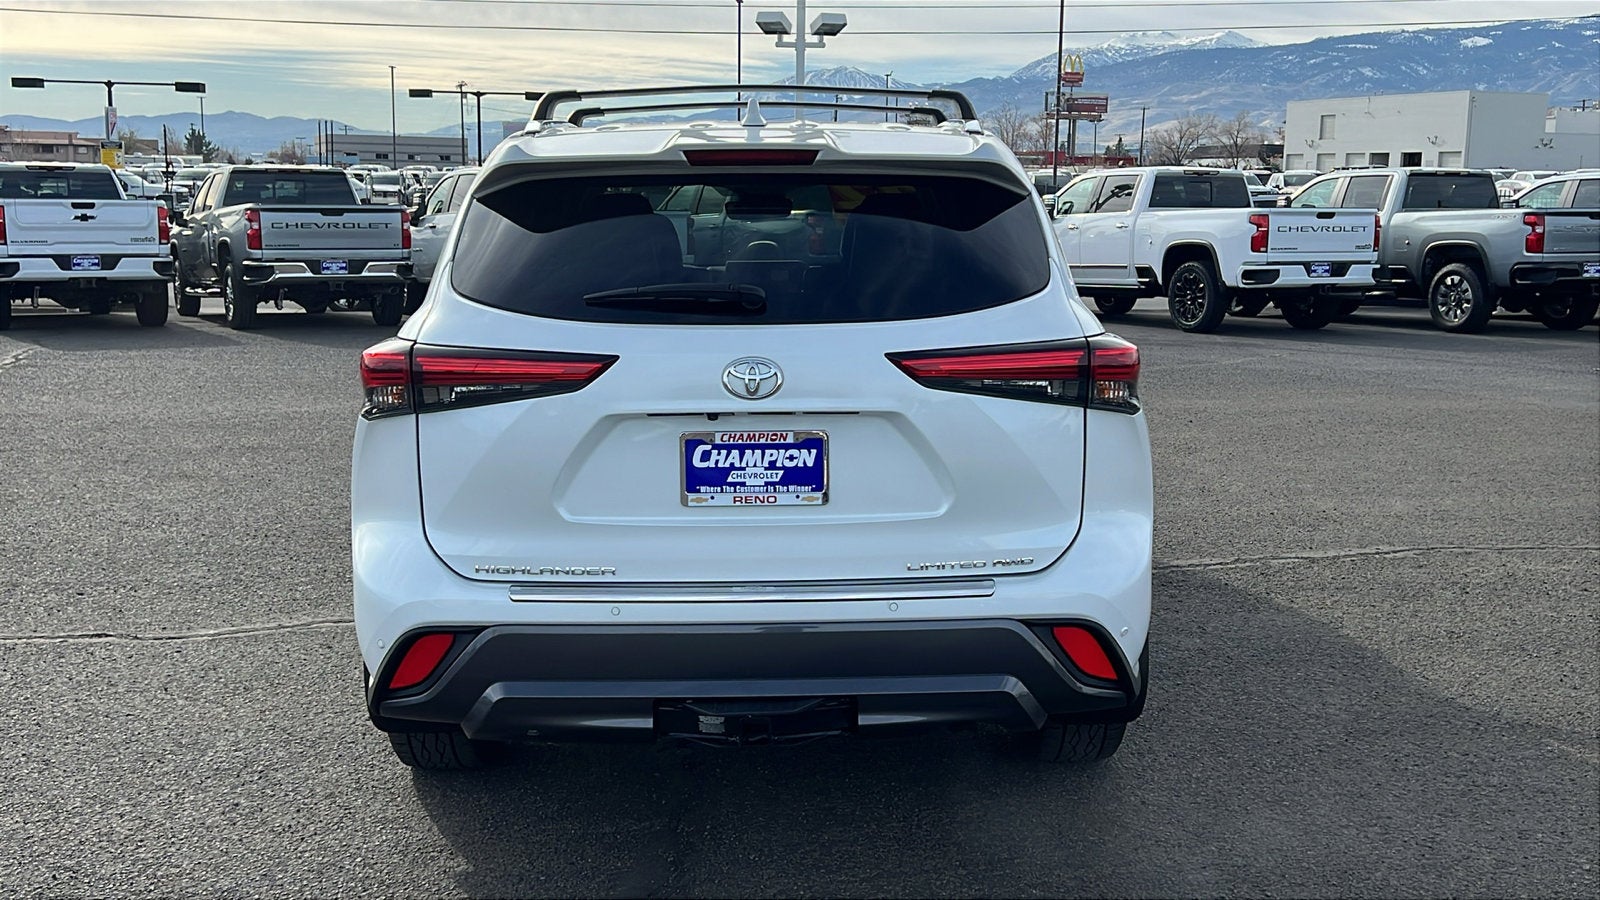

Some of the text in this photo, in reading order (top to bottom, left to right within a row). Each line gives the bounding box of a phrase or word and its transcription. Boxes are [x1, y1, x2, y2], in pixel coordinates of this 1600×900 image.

[271, 222, 393, 230] CHEVROLET
[1277, 225, 1368, 233] CHEVROLET
[720, 432, 789, 443] CHAMPION
[692, 444, 817, 468] CHAMPION
[730, 472, 780, 480] CHEVROLET
[696, 485, 816, 493] "Where The Customer Is The Winner"
[733, 495, 777, 504] RENO
[907, 557, 1034, 571] LIMITED AWD
[474, 564, 617, 576] HIGHLANDER
